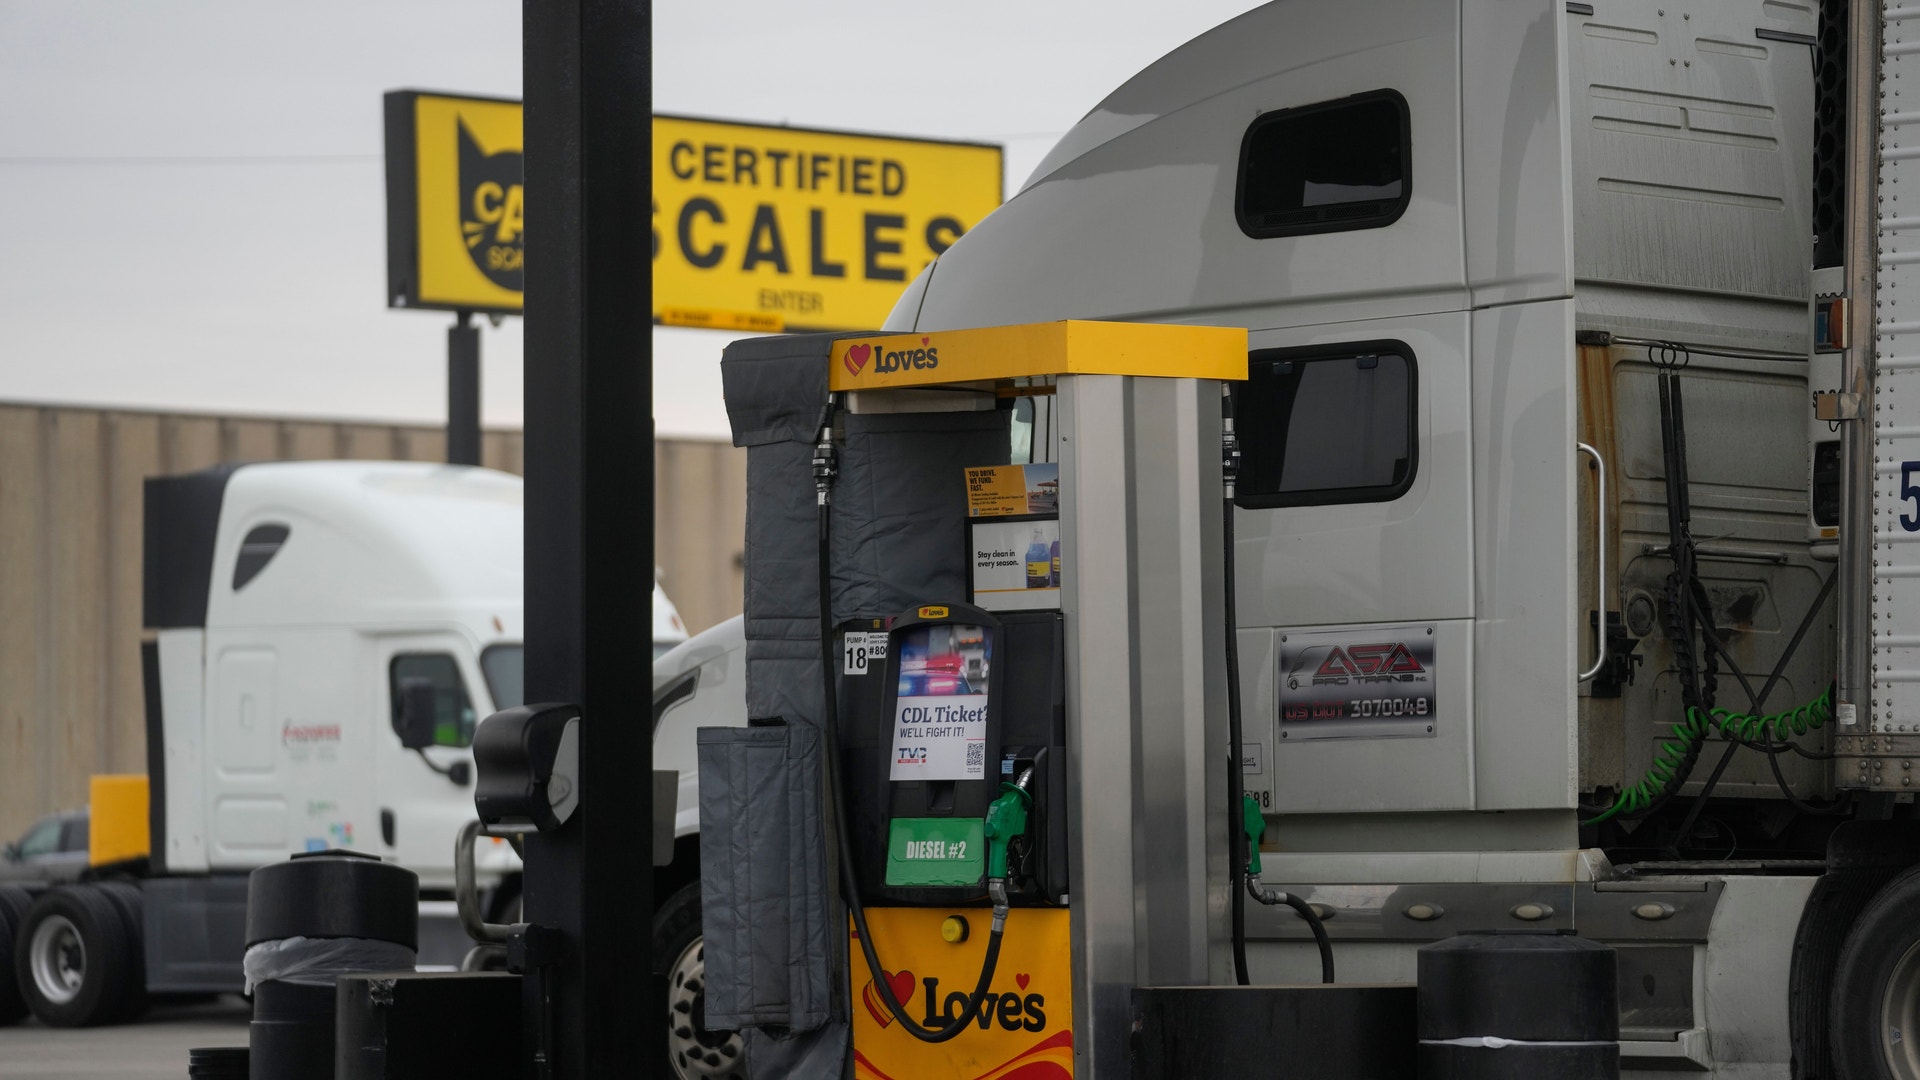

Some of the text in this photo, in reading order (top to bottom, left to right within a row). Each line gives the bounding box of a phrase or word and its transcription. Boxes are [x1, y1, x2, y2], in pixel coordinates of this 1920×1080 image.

[670, 141, 907, 198] CERTIFIED
[474, 181, 523, 243] CA
[653, 194, 967, 283] CALES
[757, 287, 824, 315] ENTER
[977, 549, 1016, 560] Stay clean in
[846, 647, 866, 669] 18
[869, 646, 888, 655] #80
[1313, 642, 1425, 677] ASA
[1312, 677, 1349, 687] PRO
[1353, 674, 1414, 685] TRANS
[901, 707, 932, 724] CDL
[1286, 697, 1428, 720] US DOT 3070048
[900, 726, 965, 738] WE'LL FIGHT IT!
[906, 840, 967, 860] DIESEL #2
